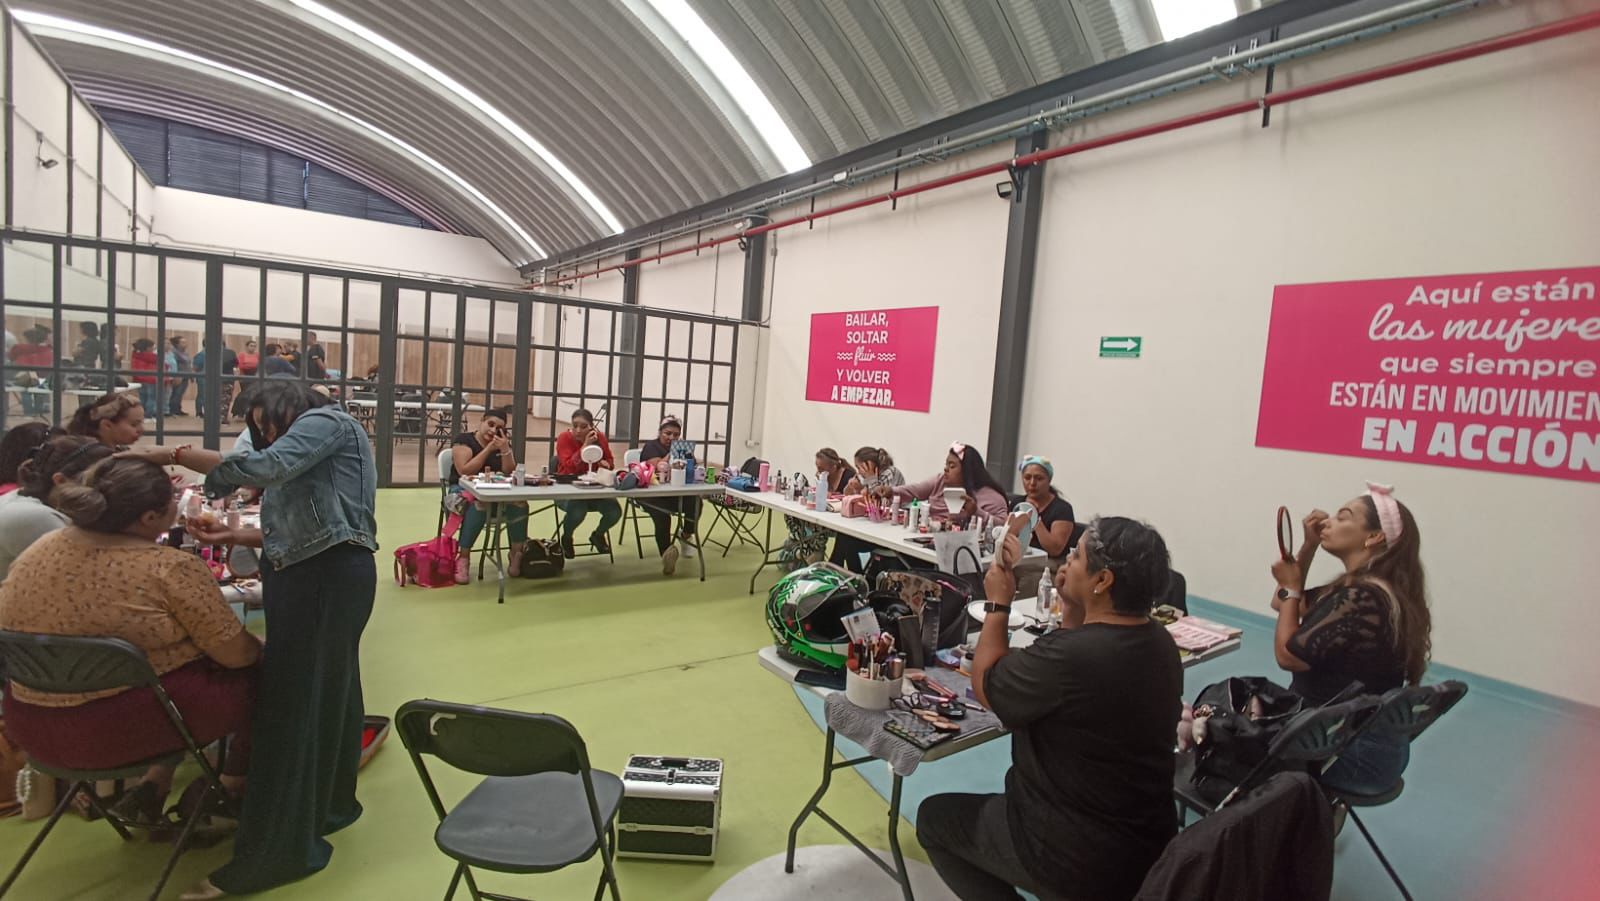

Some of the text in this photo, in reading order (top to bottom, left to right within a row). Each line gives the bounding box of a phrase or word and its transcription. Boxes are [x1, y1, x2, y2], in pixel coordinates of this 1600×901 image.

[1406, 276, 1595, 308] Aquí están
[845, 312, 889, 327] BAILAR,
[1368, 303, 1600, 353] las mujere
[846, 330, 888, 344] SOLTAR
[854, 345, 876, 366] fluir
[1380, 352, 1597, 381] que siempre
[836, 368, 890, 384] Y VOLVER
[831, 385, 895, 407] A EMPEZAR.
[1329, 378, 1405, 411] ESTÁN
[1411, 384, 1447, 412] EN
[1361, 416, 1600, 473] EN ACCIÓN
